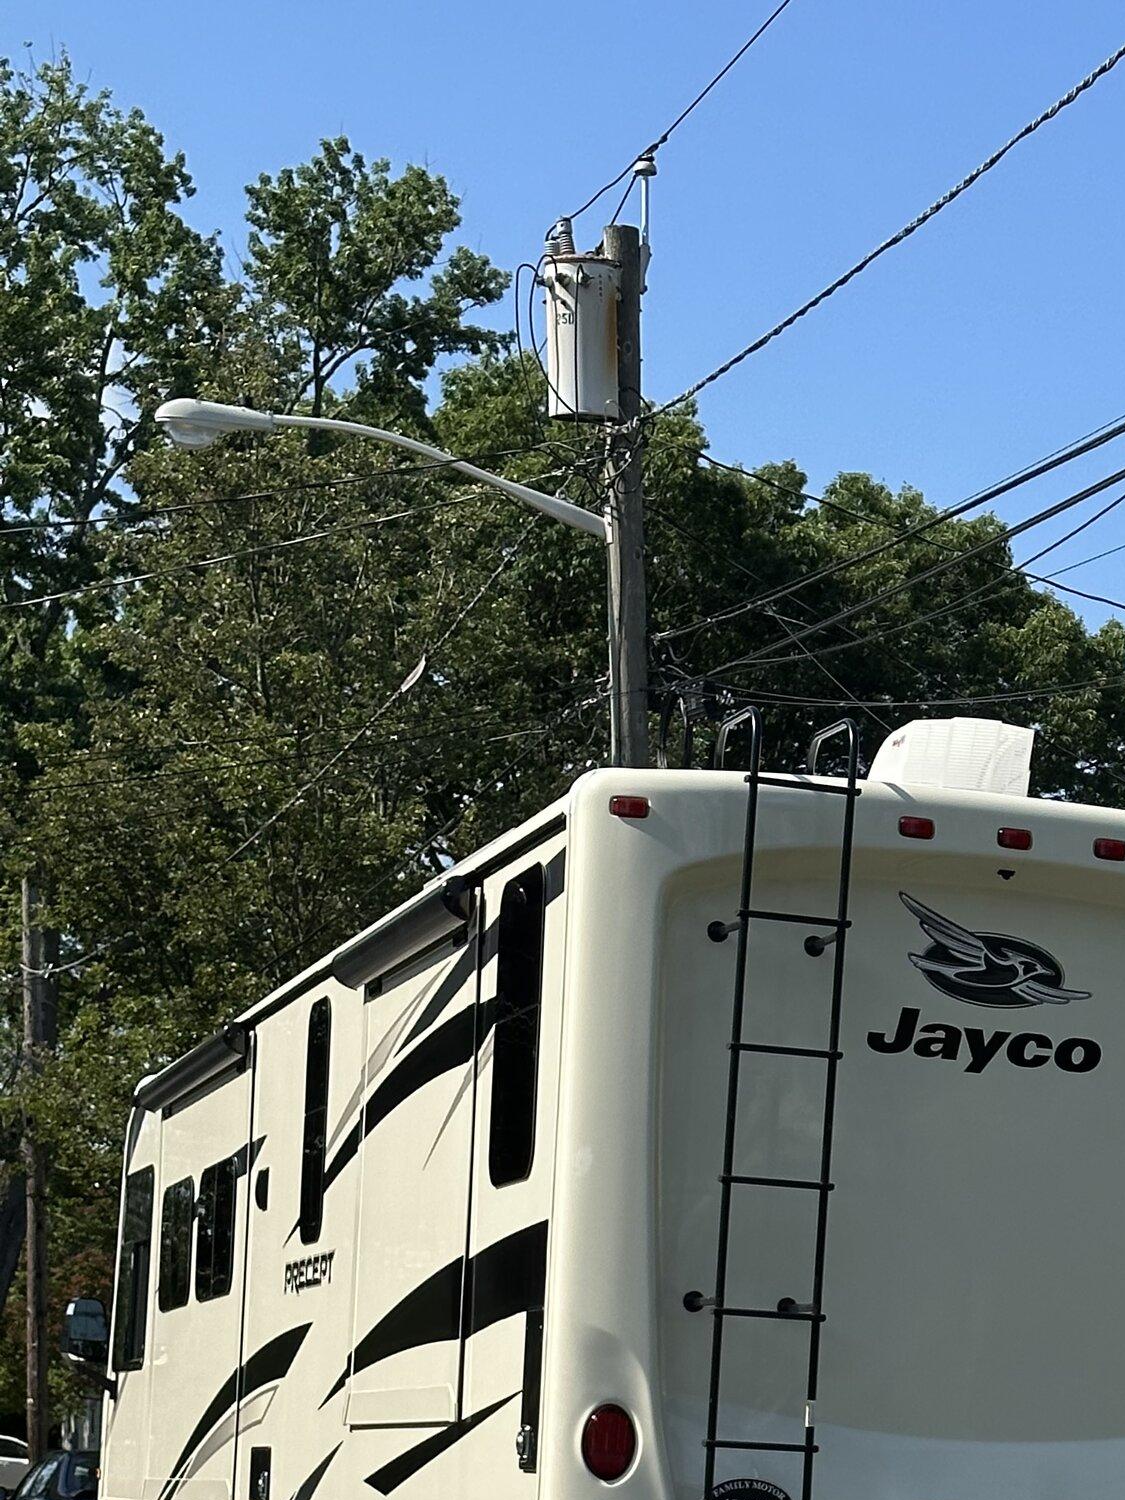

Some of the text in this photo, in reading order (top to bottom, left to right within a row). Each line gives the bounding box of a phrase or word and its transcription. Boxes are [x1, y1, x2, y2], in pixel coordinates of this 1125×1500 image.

[866, 1007, 1101, 1074] Jayco
[284, 1250, 336, 1295] PRECEPT
[712, 1480, 786, 1500] FAMILY MOTOR
